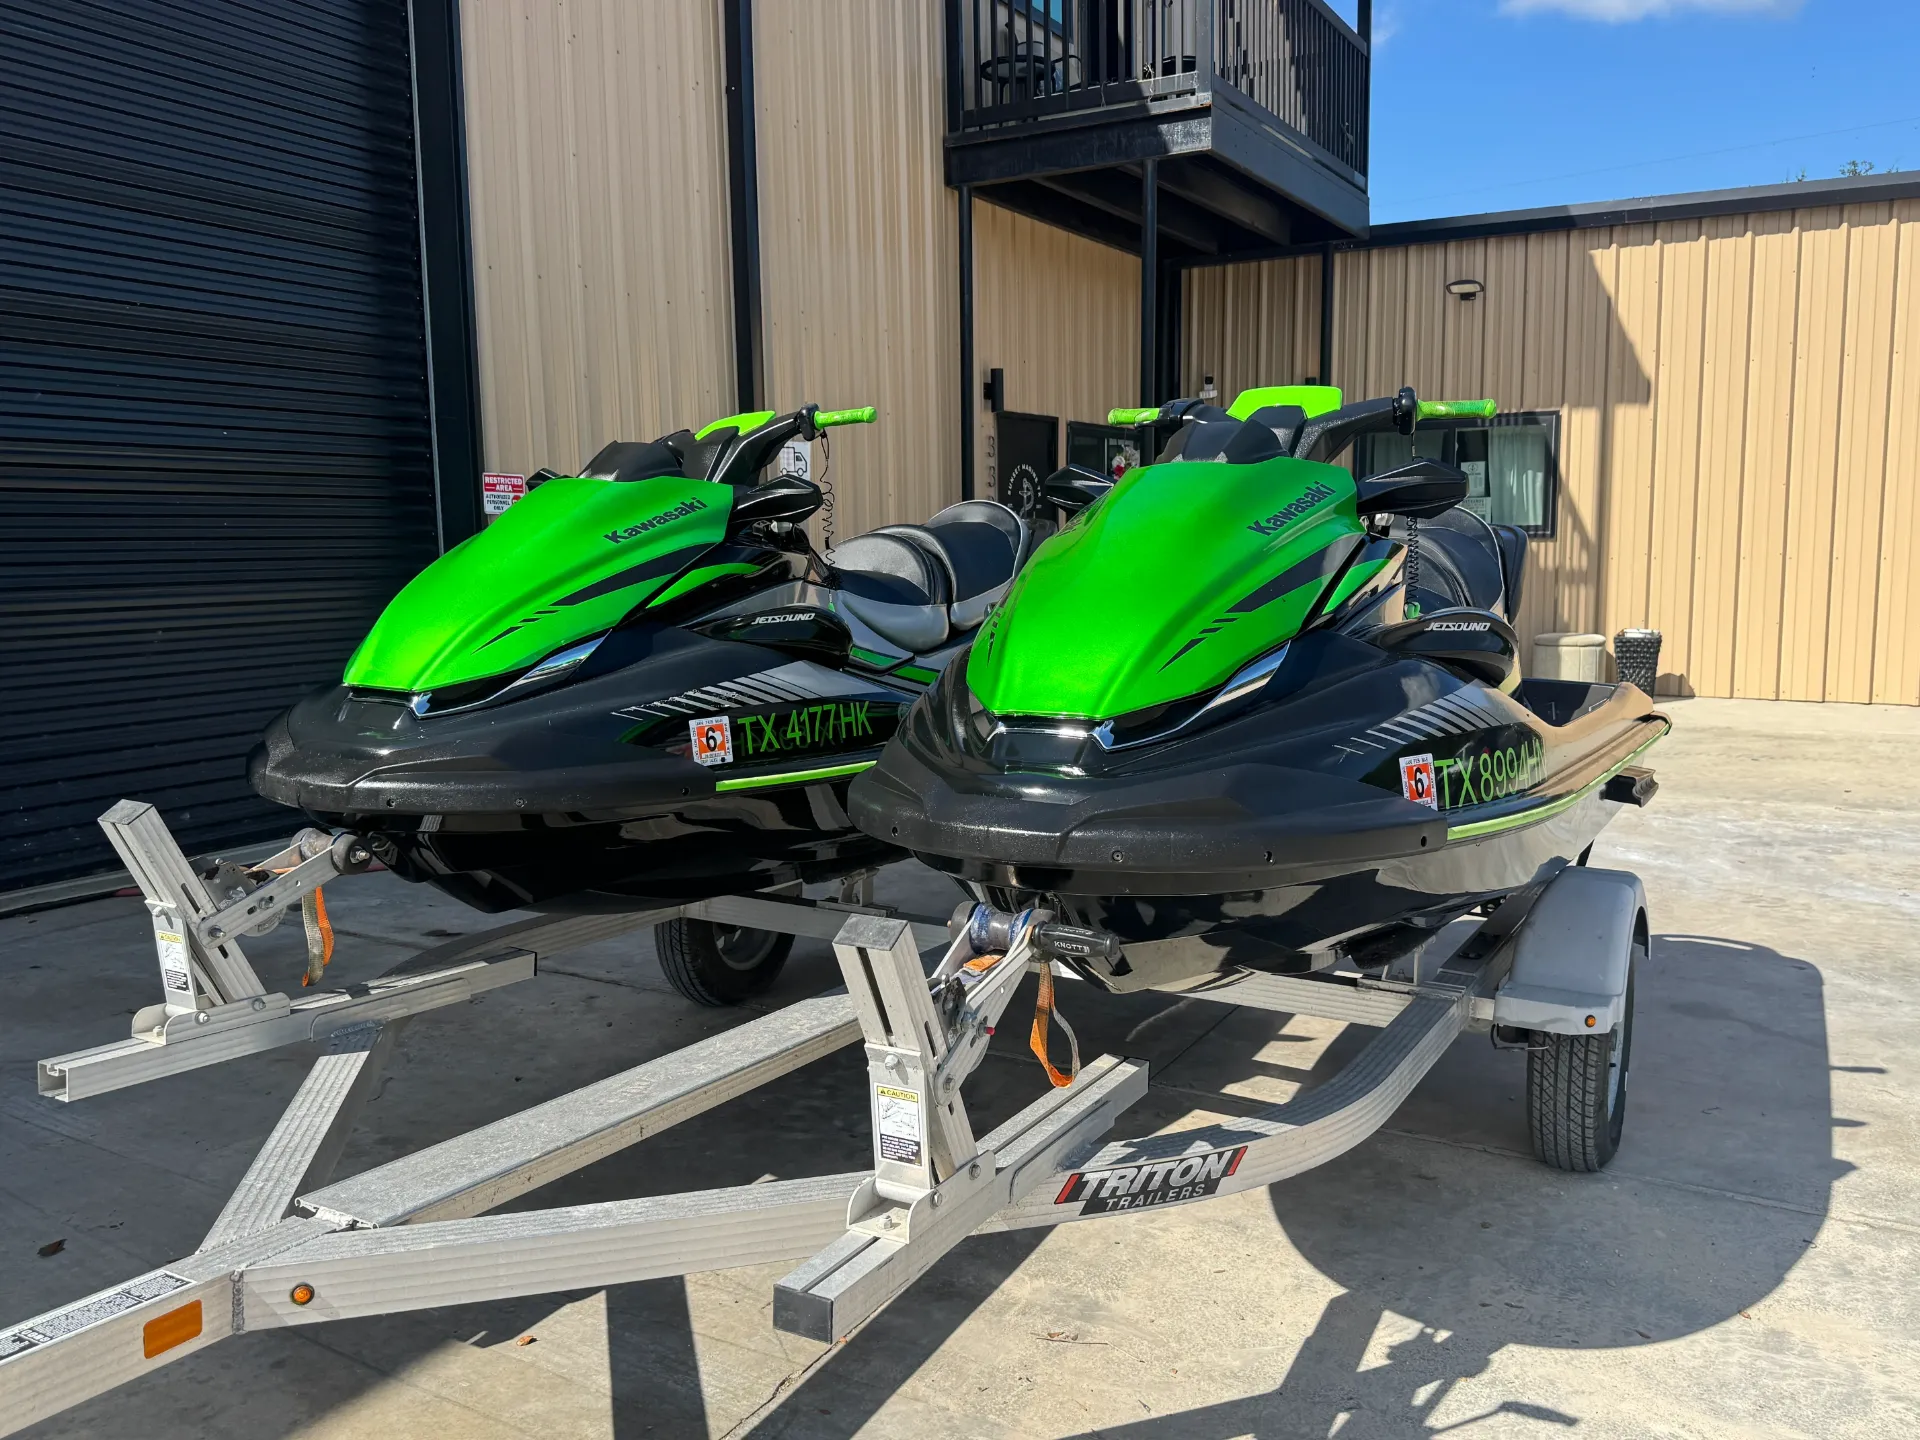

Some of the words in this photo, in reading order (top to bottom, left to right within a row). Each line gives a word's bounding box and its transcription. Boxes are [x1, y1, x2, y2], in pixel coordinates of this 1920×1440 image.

[484, 476, 522, 484] RESTRICTED
[603, 496, 708, 544] Kawasaki
[1247, 481, 1336, 536] Kawasaki
[751, 613, 816, 625] JETSOUND
[1424, 622, 1491, 632] JETSOUND
[705, 726, 717, 752] 6
[737, 713, 780, 754] TX
[786, 700, 873, 746] 4177HK
[1414, 766, 1425, 798] 6
[1434, 756, 1478, 809] TX
[886, 1089, 916, 1101] CAUTION
[1079, 1150, 1234, 1201] TRITON
[1106, 1184, 1205, 1212] TRAILERS
